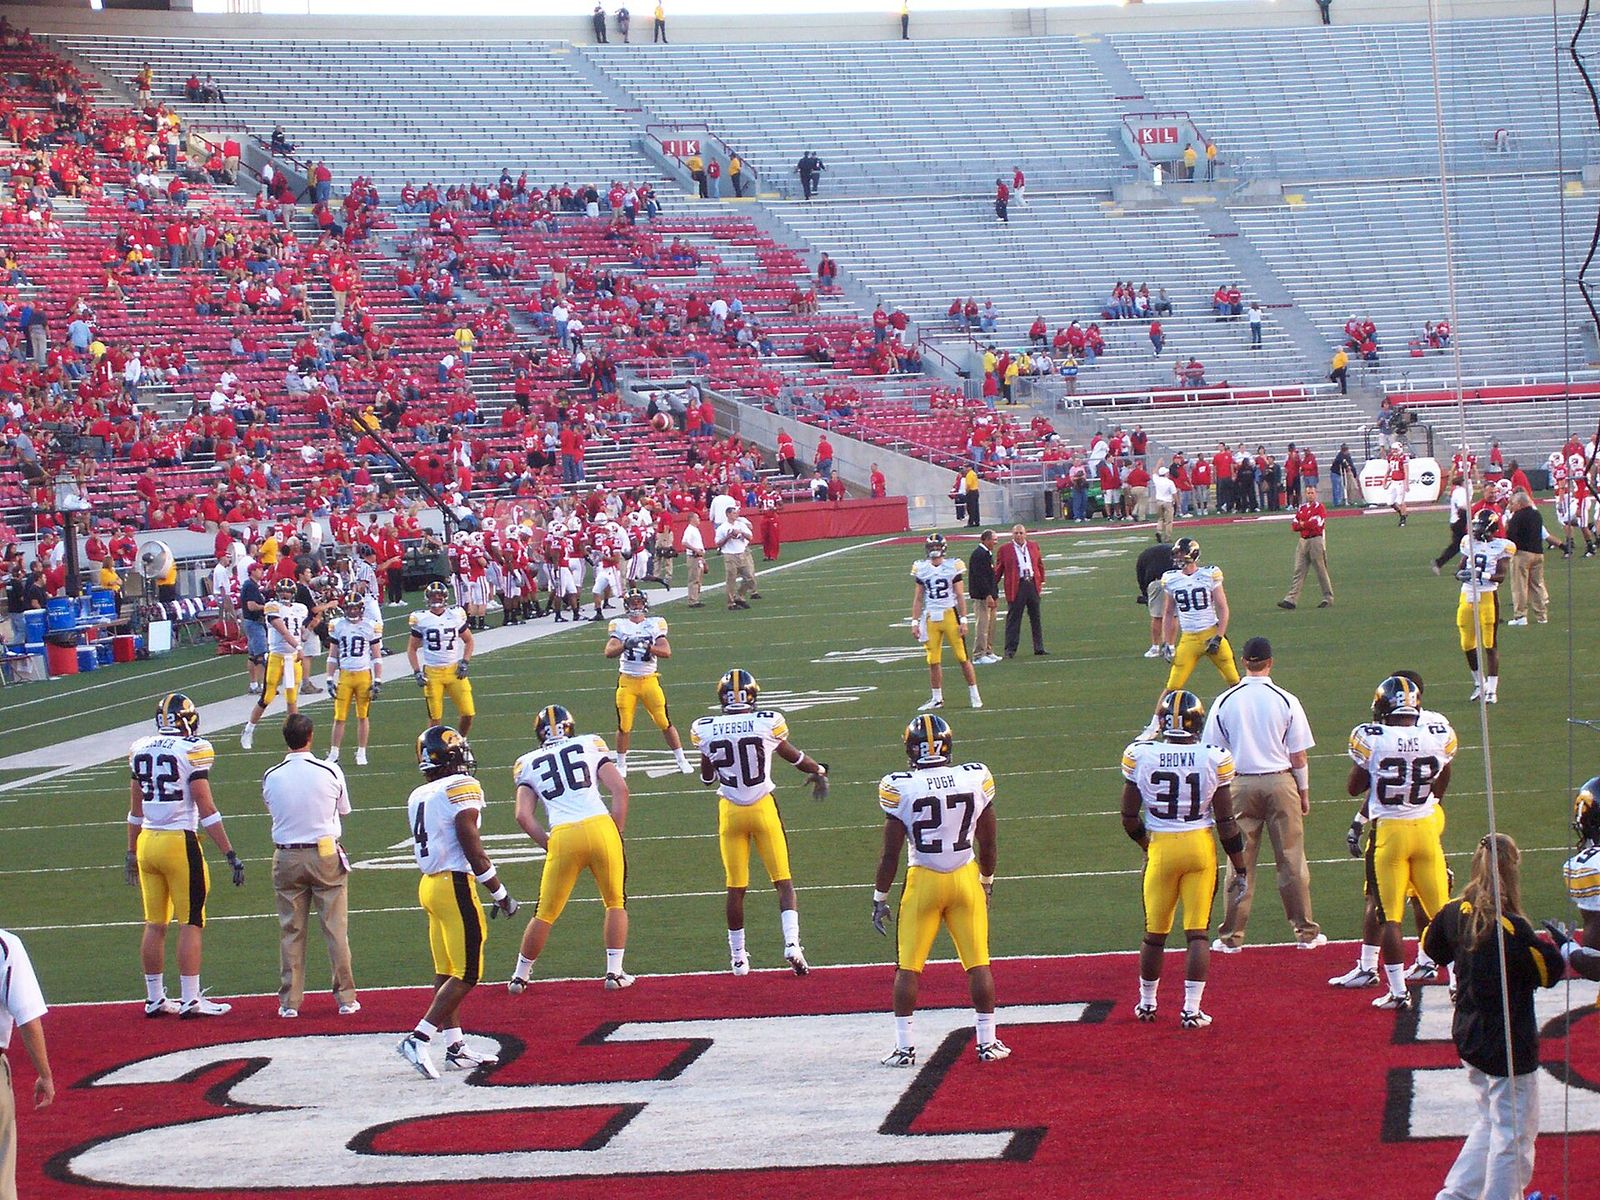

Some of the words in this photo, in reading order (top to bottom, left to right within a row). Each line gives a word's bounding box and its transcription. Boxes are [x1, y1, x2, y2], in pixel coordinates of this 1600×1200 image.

[1143, 128, 1154, 143] K
[1164, 128, 1174, 143] L
[686, 141, 697, 155] K
[924, 578, 949, 600] 12
[1174, 586, 1209, 612] 90
[341, 635, 365, 657] 10
[426, 627, 456, 651] 97
[712, 720, 755, 736] EVERSON
[919, 740, 944, 756] 27
[1397, 737, 1420, 753] SIMS
[709, 736, 766, 789] 20
[1159, 752, 1196, 768] BROWN
[531, 744, 592, 801] 36
[926, 774, 956, 791] PUGH
[1148, 771, 1204, 822] 31
[413, 801, 430, 858] 4
[912, 792, 975, 854] 27
